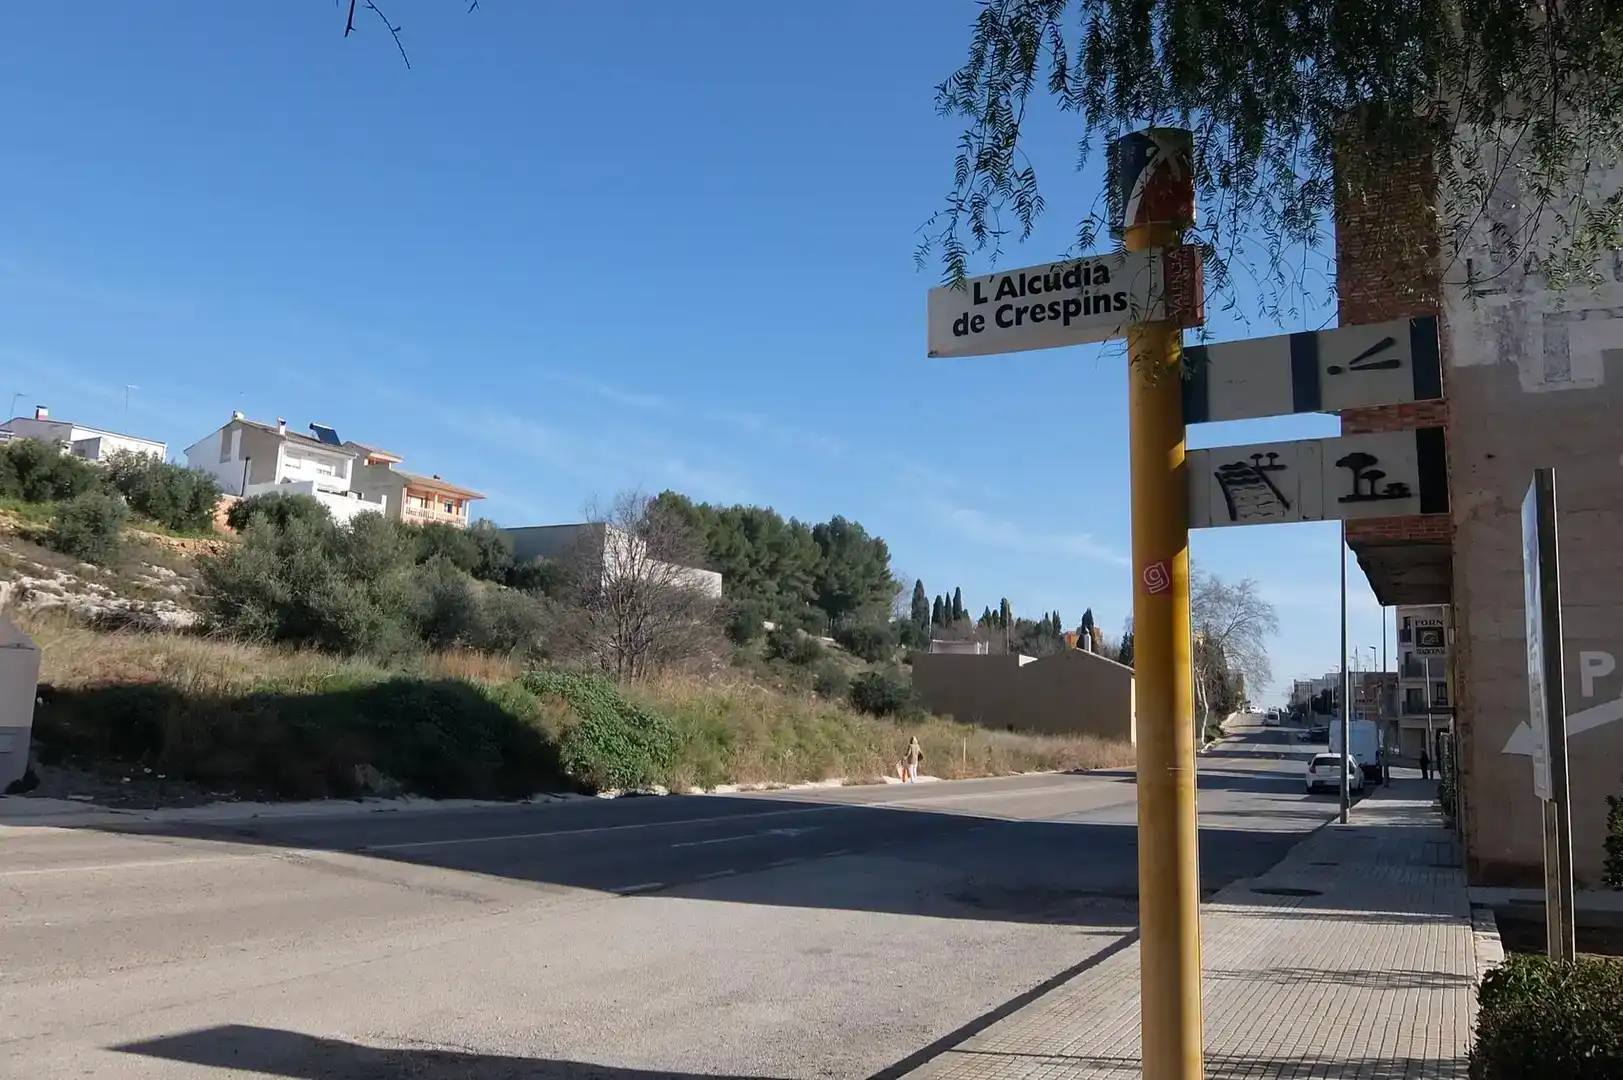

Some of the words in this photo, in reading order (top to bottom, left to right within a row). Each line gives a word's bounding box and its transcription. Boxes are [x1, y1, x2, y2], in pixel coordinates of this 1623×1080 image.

[952, 311, 986, 338] de
[995, 290, 1128, 327] Crespins
[1415, 619, 1444, 627] FORN
